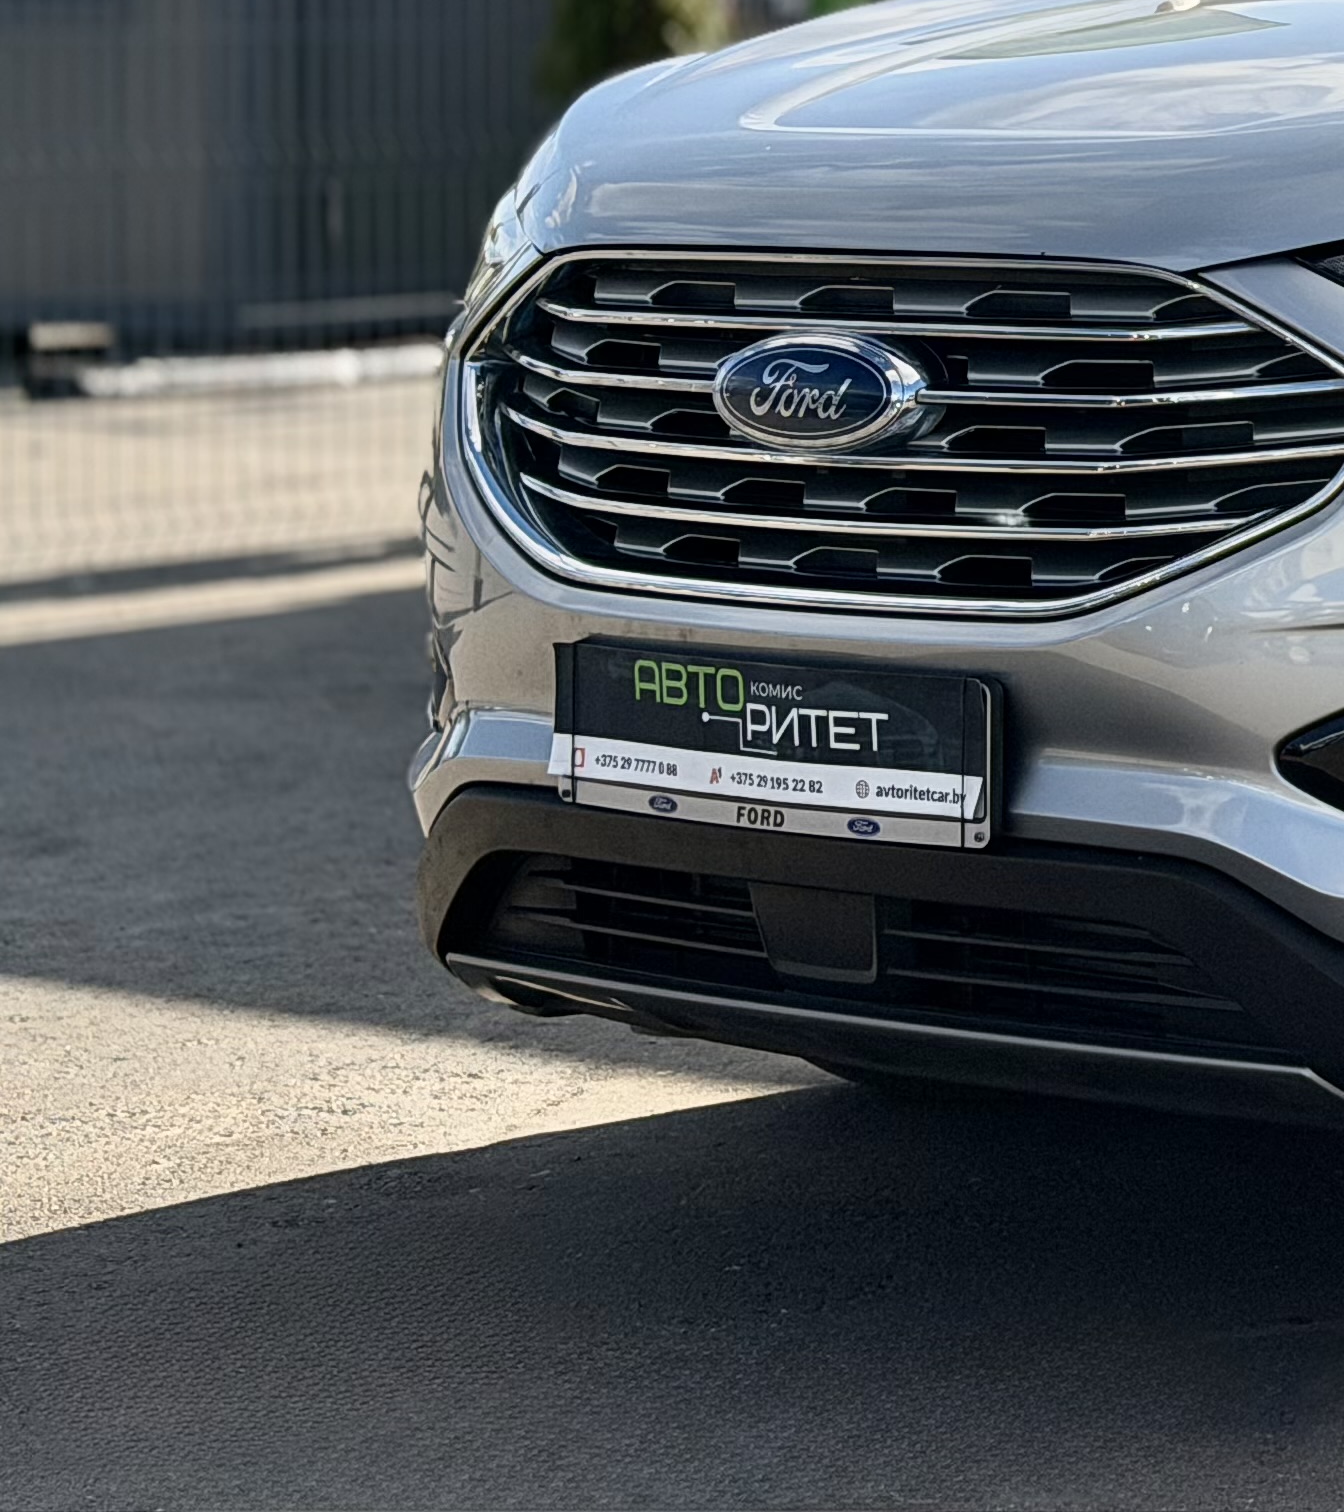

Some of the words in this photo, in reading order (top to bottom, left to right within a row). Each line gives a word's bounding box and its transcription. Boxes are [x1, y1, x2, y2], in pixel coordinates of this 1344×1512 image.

[750, 358, 853, 421] Ford
[634, 659, 744, 712] АВТО
[746, 702, 889, 752] РИТЕТ
[595, 754, 618, 769] +375
[620, 756, 632, 770] 29
[634, 758, 656, 774] 7777
[730, 771, 755, 786] +375
[756, 774, 768, 788] 29
[770, 776, 789, 791] 195
[792, 778, 806, 792] 22
[808, 779, 823, 793] 82
[736, 805, 785, 828] FORD
